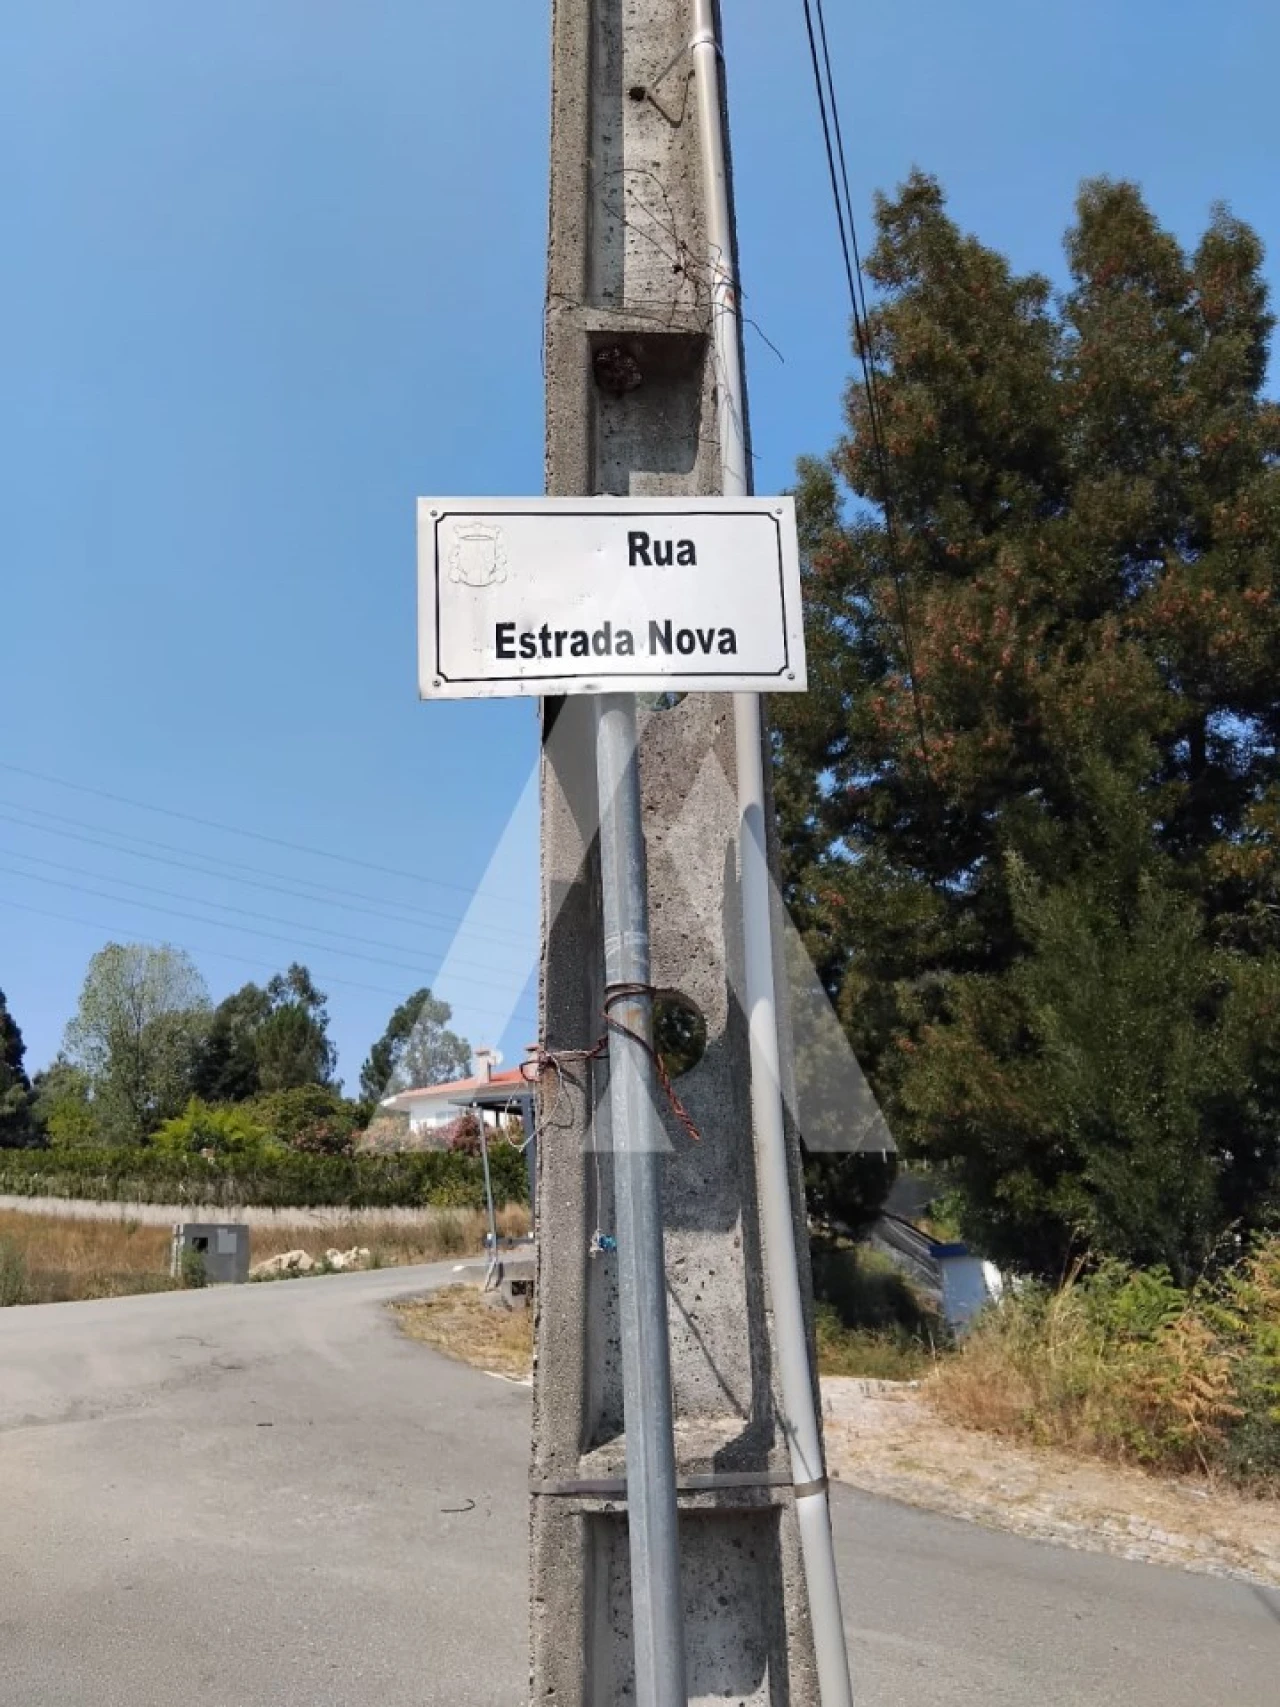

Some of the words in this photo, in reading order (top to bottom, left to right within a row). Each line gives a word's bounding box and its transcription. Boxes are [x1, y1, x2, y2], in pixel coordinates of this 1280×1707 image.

[627, 531, 697, 567] Rua
[495, 620, 635, 660] Estrada
[648, 619, 738, 656] Nova
